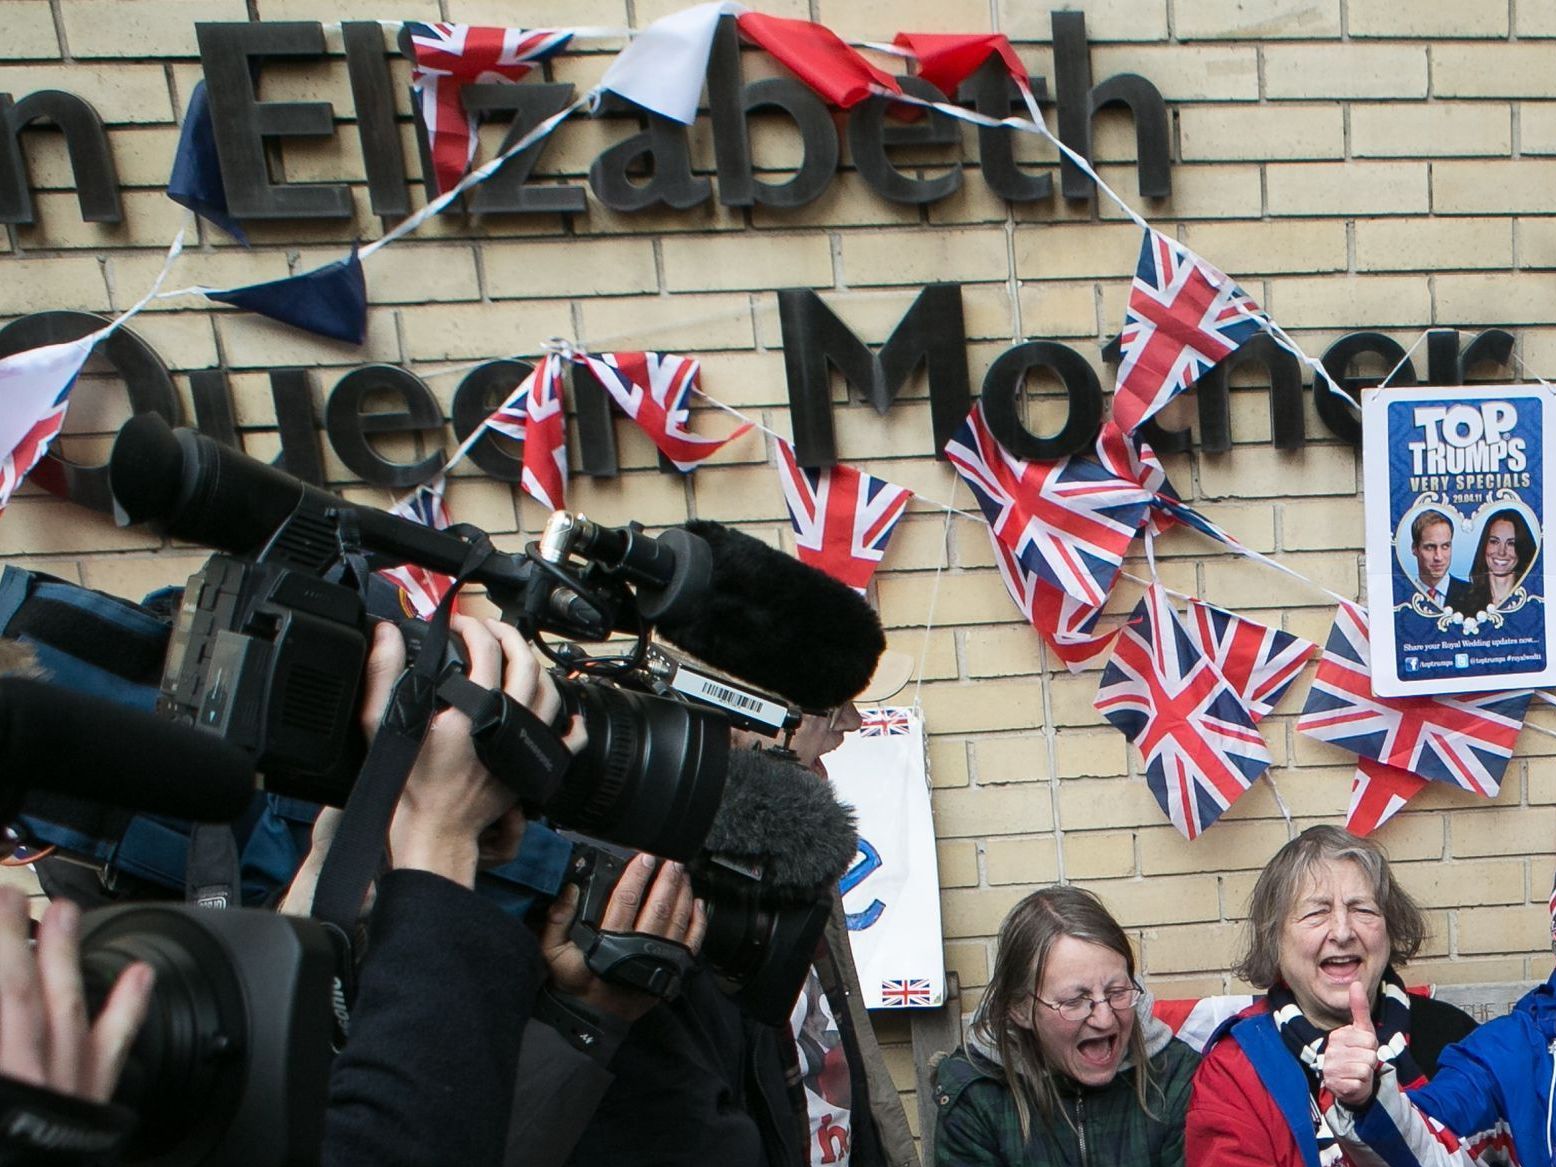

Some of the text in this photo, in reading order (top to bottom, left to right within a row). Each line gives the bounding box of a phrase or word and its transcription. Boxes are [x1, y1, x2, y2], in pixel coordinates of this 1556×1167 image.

[777, 282, 1515, 468] Moher
[1414, 401, 1518, 450] TOP
[1409, 437, 1527, 475] TRUMPS
[1410, 473, 1531, 492] VERY SPECIALS
[1403, 643, 1424, 651] Share
[1441, 640, 1461, 649] Royal
[1461, 639, 1491, 648] Wedding
